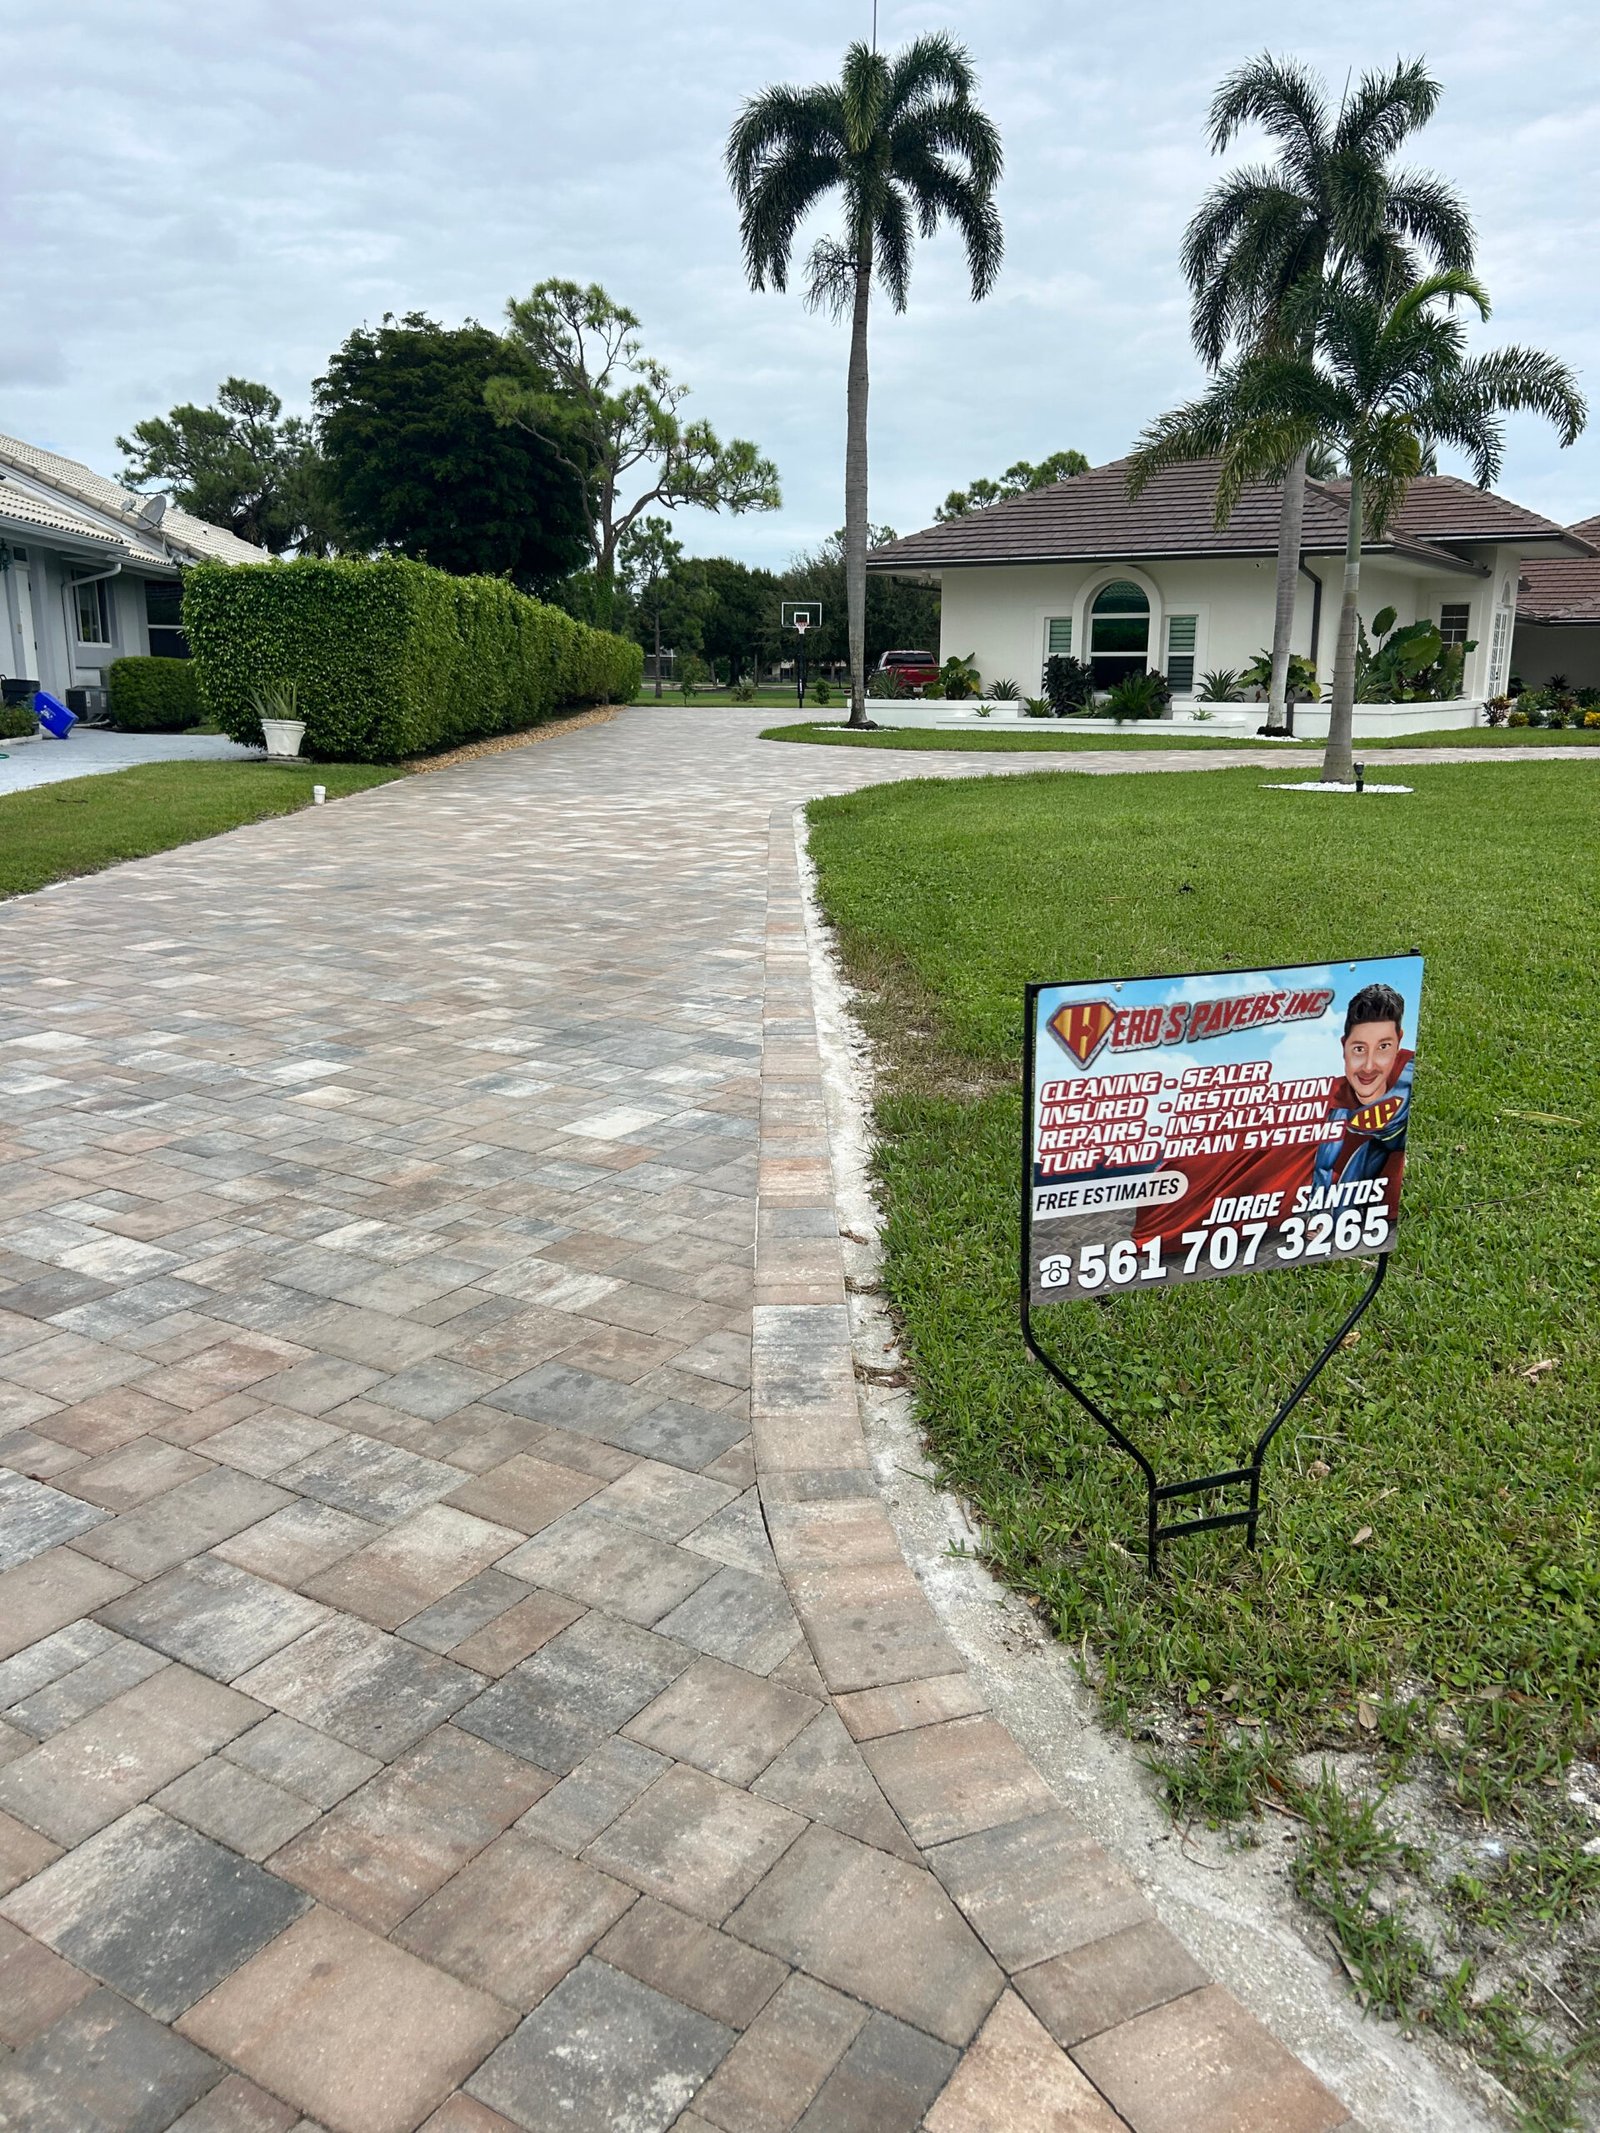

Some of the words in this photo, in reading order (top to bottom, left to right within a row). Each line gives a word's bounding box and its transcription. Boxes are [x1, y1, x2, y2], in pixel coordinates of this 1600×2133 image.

[1188, 993, 1287, 1036] PAVERS
[1284, 992, 1330, 1016] INC
[1040, 1098, 1146, 1127] INSURED
[1175, 1078, 1333, 1113] RESTORATION
[1041, 1073, 1160, 1102] CLEANING
[1182, 1063, 1269, 1089] SEALER
[1040, 1121, 1145, 1150] REPAIRS
[1166, 1101, 1329, 1136] INSTALLATION
[1041, 1149, 1102, 1173] TURF
[1105, 1142, 1160, 1166] AND
[1163, 1134, 1238, 1159] DRAIN
[1243, 1121, 1345, 1149] SYSTEMS
[1036, 1190, 1079, 1211] FREE
[1082, 1177, 1180, 1205] ESTIMATES
[1202, 1191, 1285, 1226] JORGE
[1291, 1177, 1389, 1213] SANTOS
[1077, 1235, 1168, 1289] 561
[1181, 1222, 1268, 1274] 707
[1276, 1205, 1390, 1260] 3265
